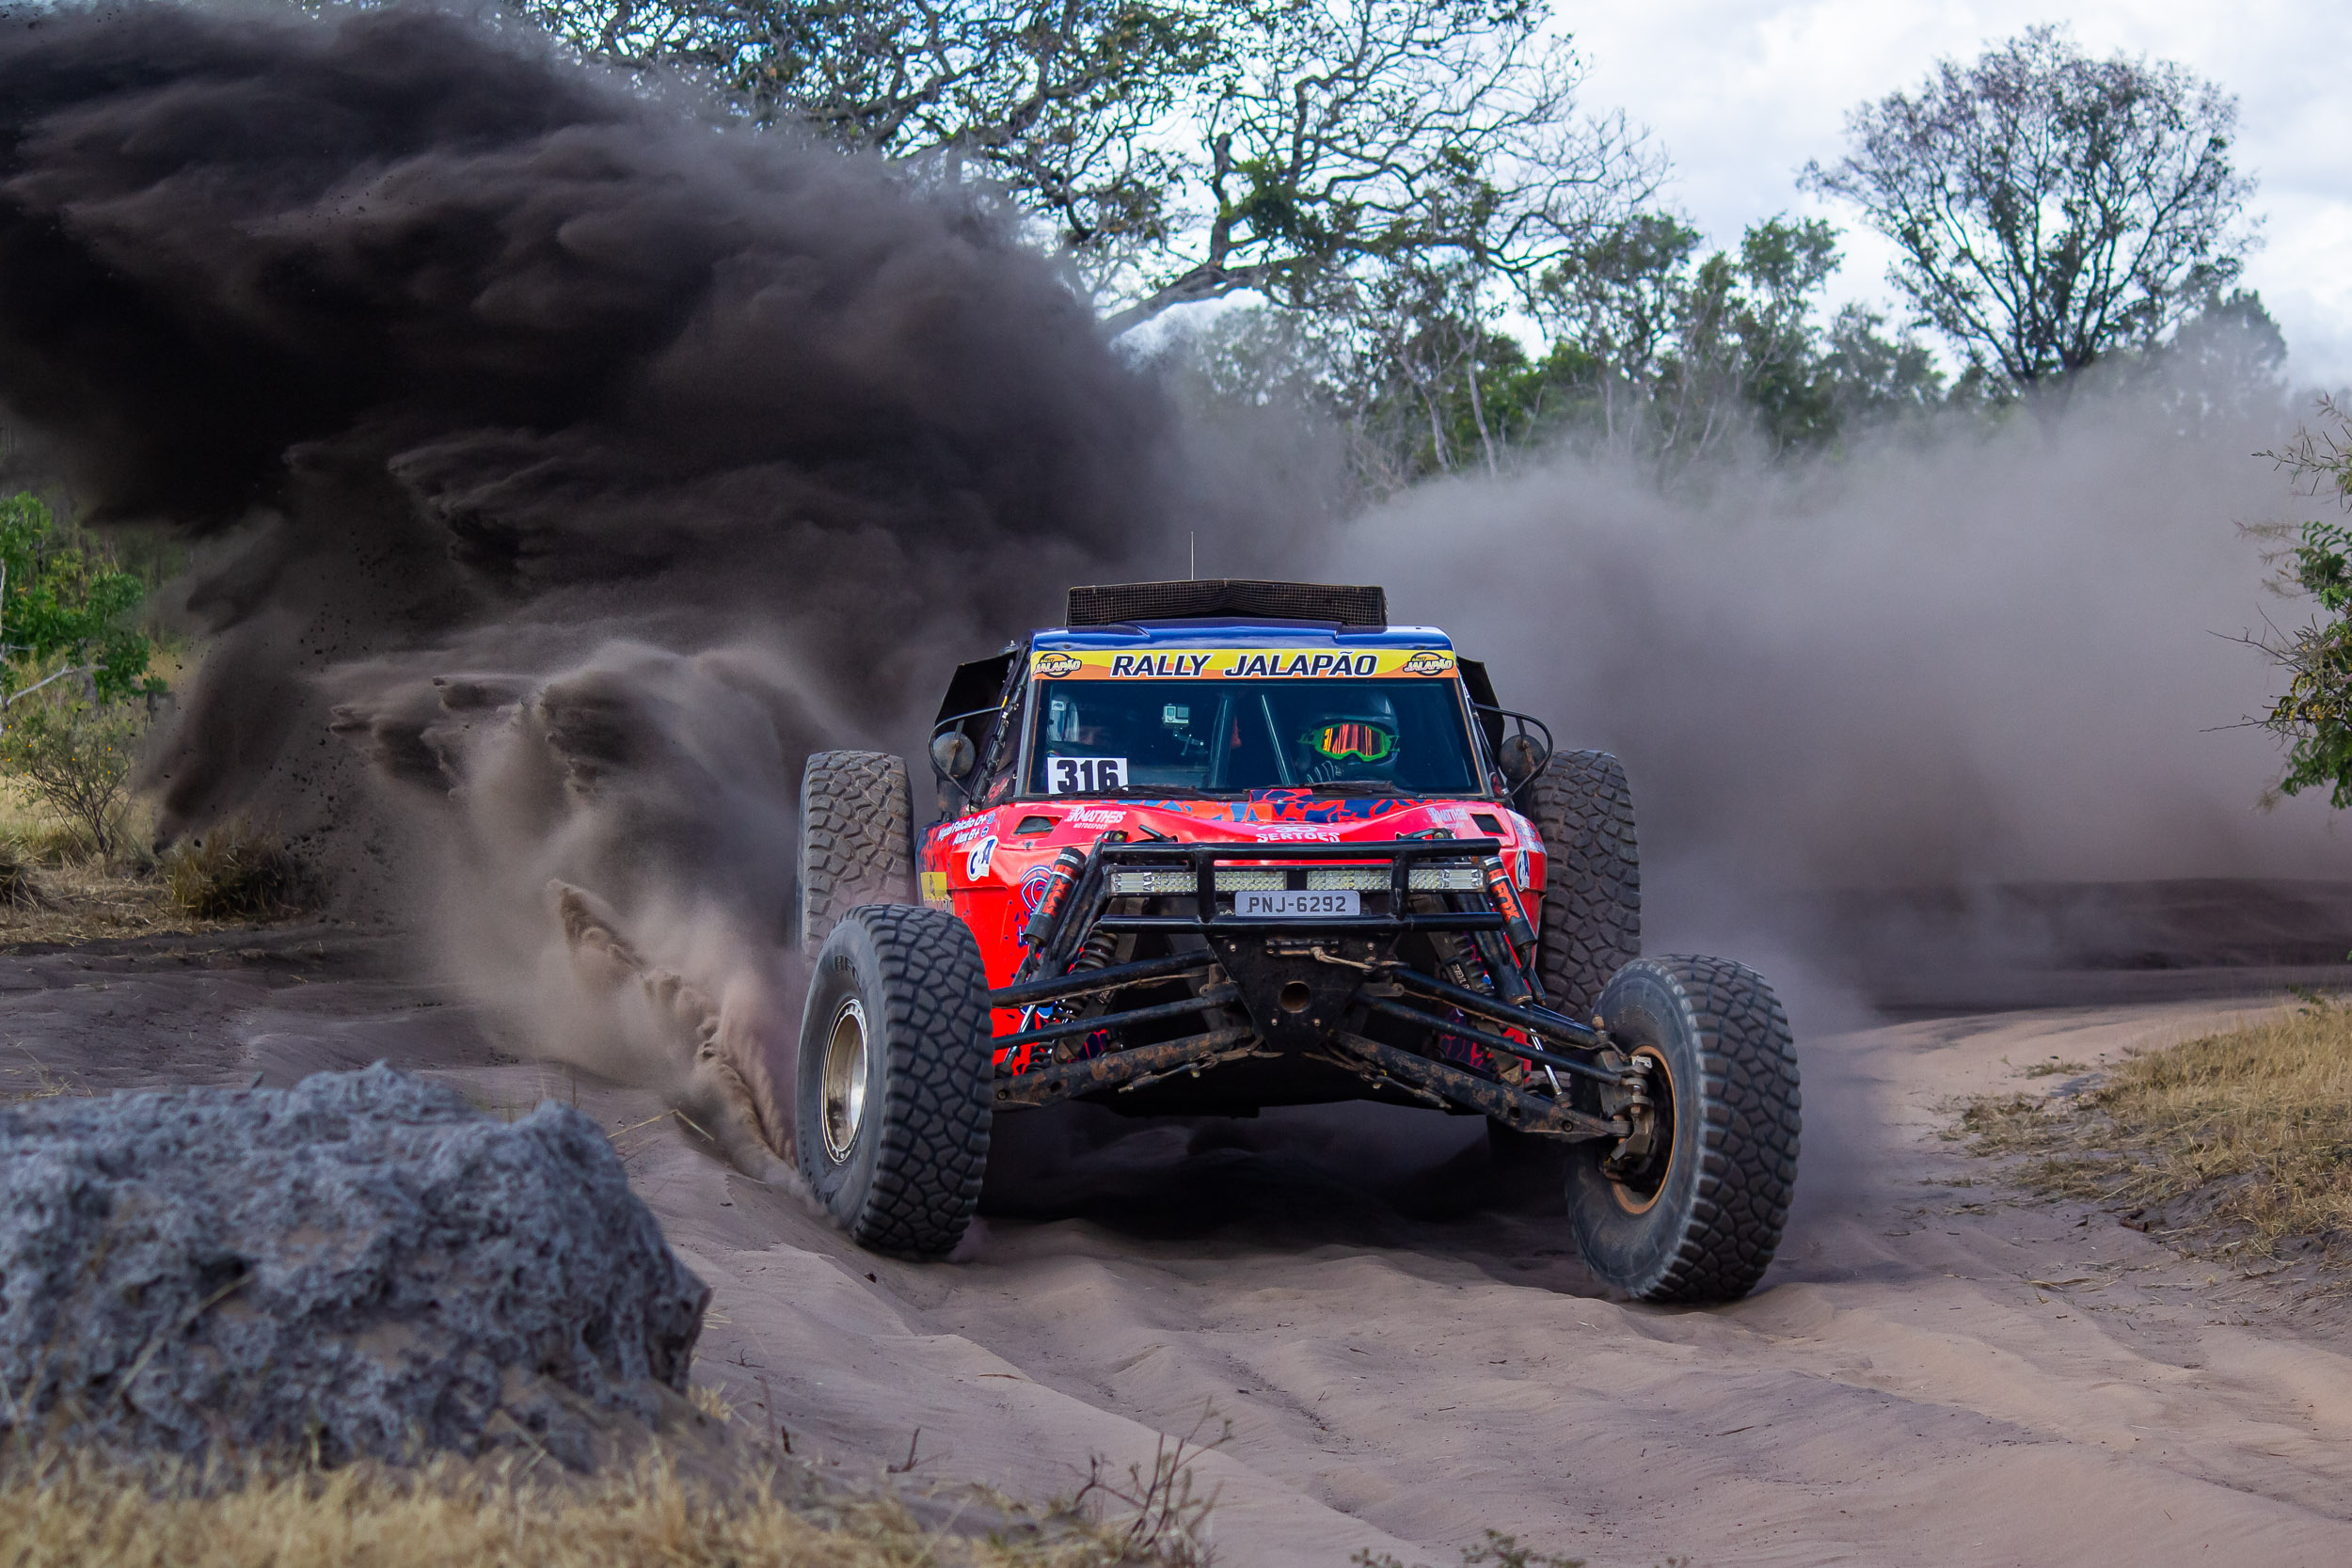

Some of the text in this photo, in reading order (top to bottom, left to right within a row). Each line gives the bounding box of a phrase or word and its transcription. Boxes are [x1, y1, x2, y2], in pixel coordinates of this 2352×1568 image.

[1033, 658, 1081, 674] JALAPÃO
[1111, 651, 1378, 677] RALLY JALAPÃO
[1404, 658, 1453, 671] JALAPÃO
[1057, 759, 1119, 793] 316
[1247, 896, 1346, 912] PNJ-6292
[1492, 881, 1521, 924] FOX
